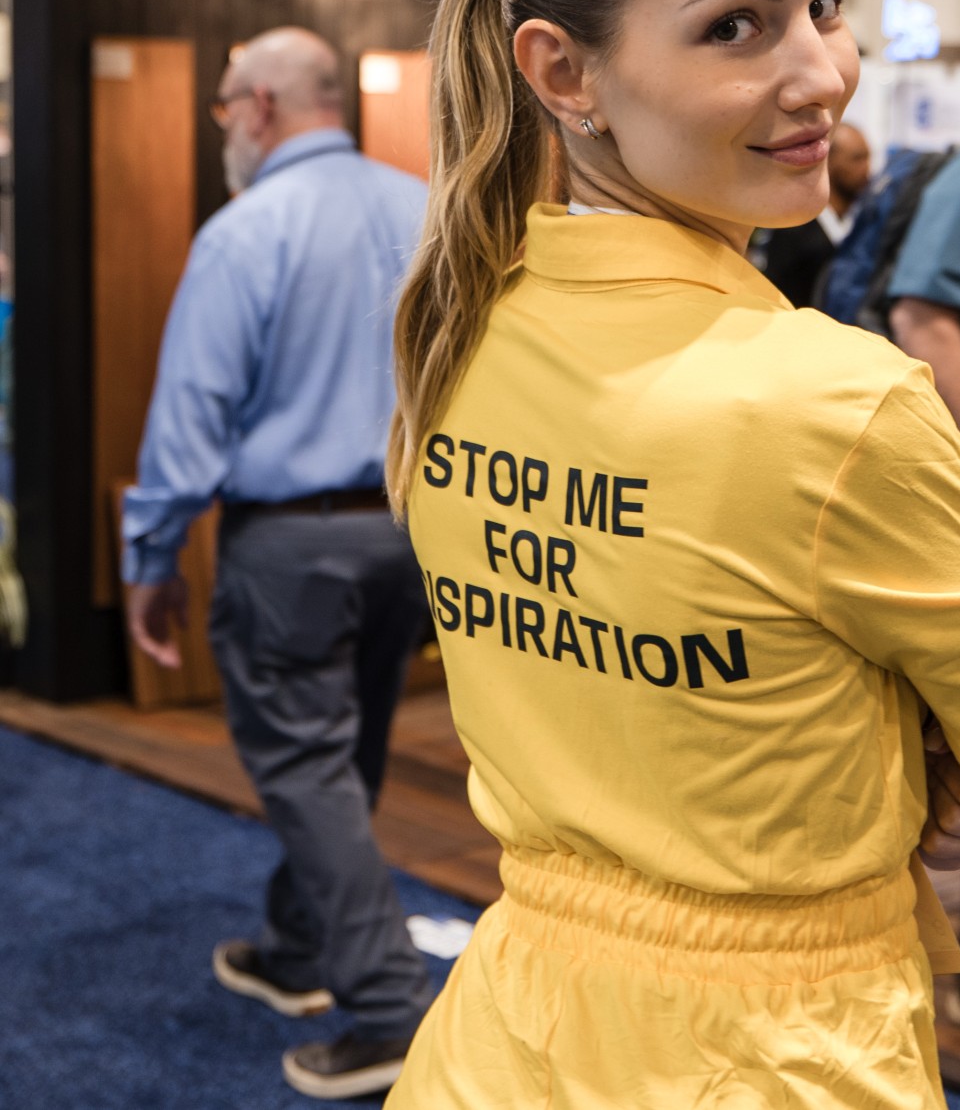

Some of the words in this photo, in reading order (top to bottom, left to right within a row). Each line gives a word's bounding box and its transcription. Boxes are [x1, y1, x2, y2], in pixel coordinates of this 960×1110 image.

[423, 432, 550, 514] STOP
[564, 466, 649, 538] ME
[484, 519, 579, 598] FOR
